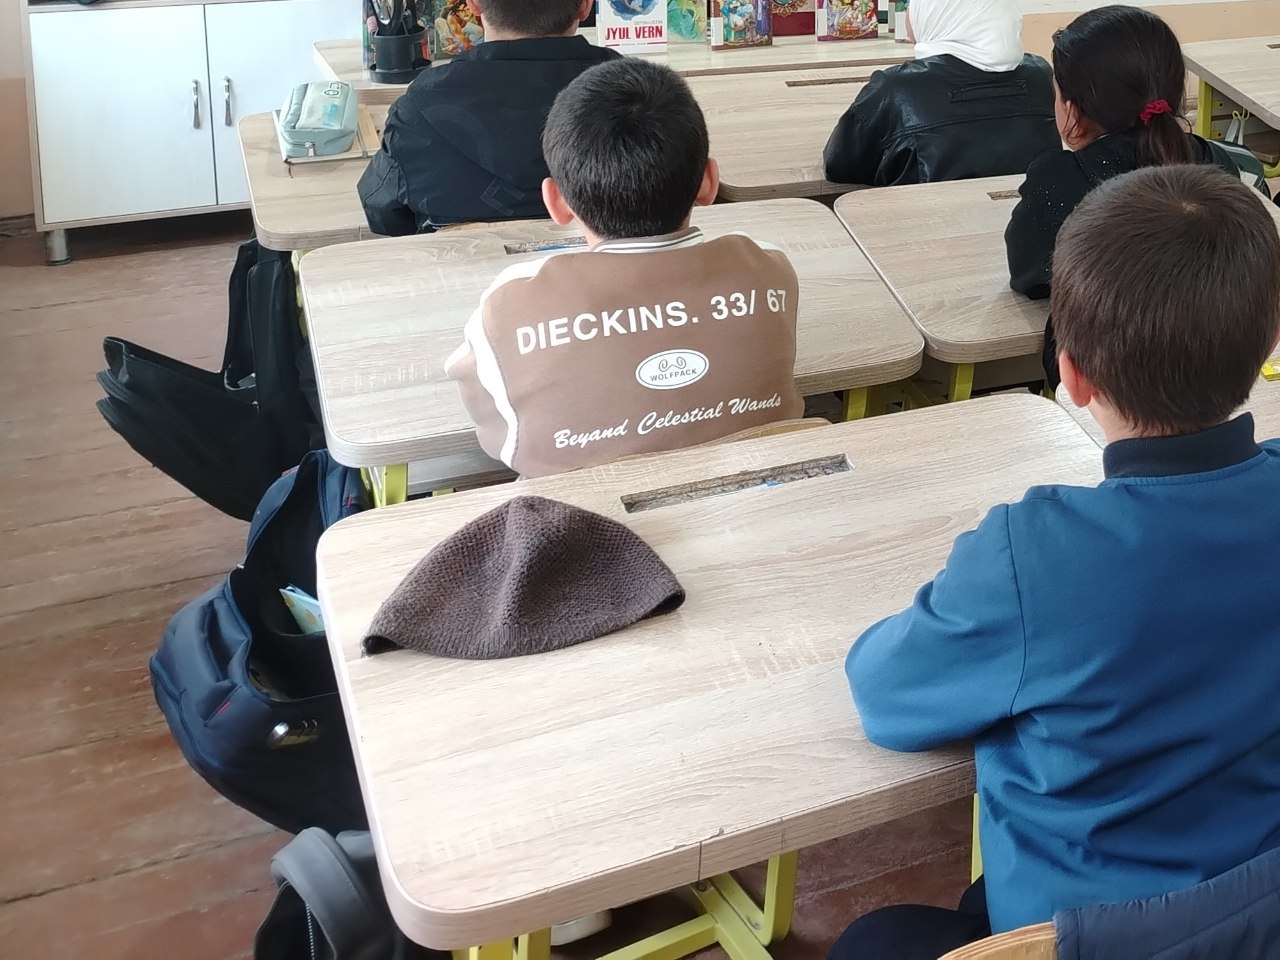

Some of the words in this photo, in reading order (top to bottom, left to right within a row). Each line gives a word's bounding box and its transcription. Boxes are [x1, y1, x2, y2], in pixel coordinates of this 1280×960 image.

[605, 27, 631, 41] JYUL
[635, 25, 663, 39] VERN
[515, 300, 699, 356] DIECKINS.
[766, 289, 787, 313] 67
[649, 367, 698, 382] WOLFPACK
[636, 400, 724, 436] Celestial
[728, 393, 782, 416] Wands
